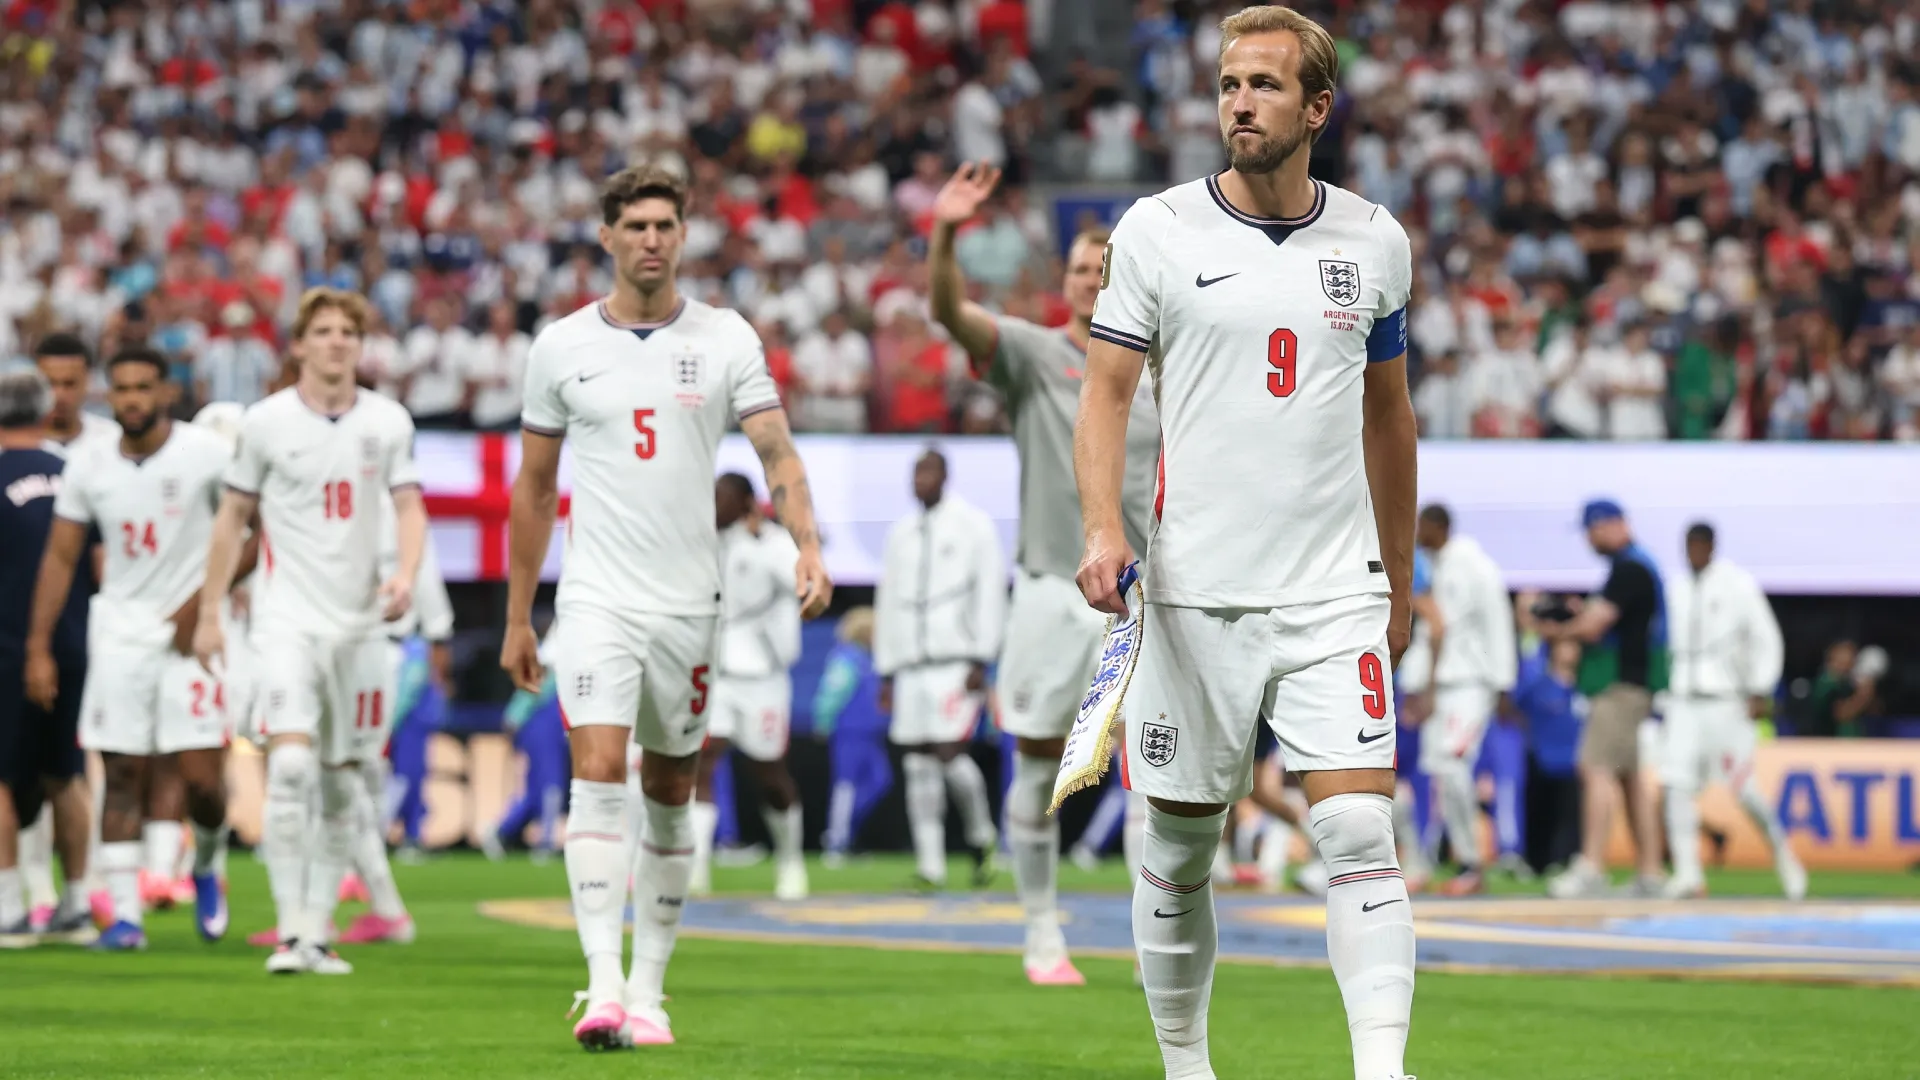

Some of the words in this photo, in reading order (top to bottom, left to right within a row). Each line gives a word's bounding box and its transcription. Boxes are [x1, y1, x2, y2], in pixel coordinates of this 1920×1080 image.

[1323, 310, 1360, 322] ARGENTINA
[1267, 328, 1297, 397] 9
[634, 409, 656, 460] 5
[323, 480, 354, 520] 18
[121, 521, 158, 558] 24
[691, 665, 709, 715] 5
[1358, 652, 1387, 720] 9
[1777, 772, 1920, 842] ATL
